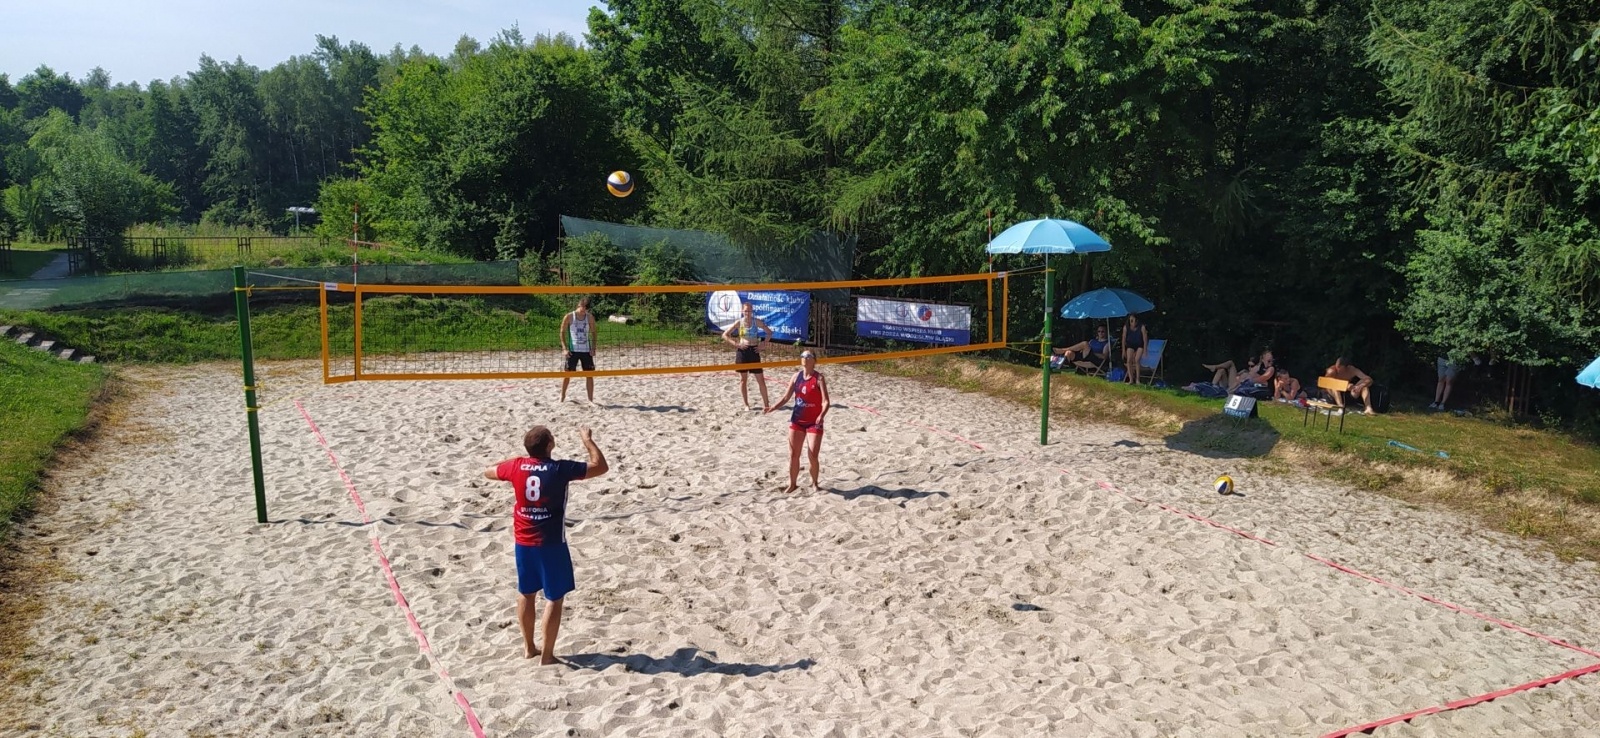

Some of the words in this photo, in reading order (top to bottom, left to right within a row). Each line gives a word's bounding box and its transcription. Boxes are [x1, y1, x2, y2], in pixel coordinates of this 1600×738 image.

[780, 323, 802, 335] Śląski
[882, 324, 903, 332] MIASTO
[802, 386, 806, 394] 4
[1232, 398, 1238, 406] 6
[526, 476, 540, 502] 8
